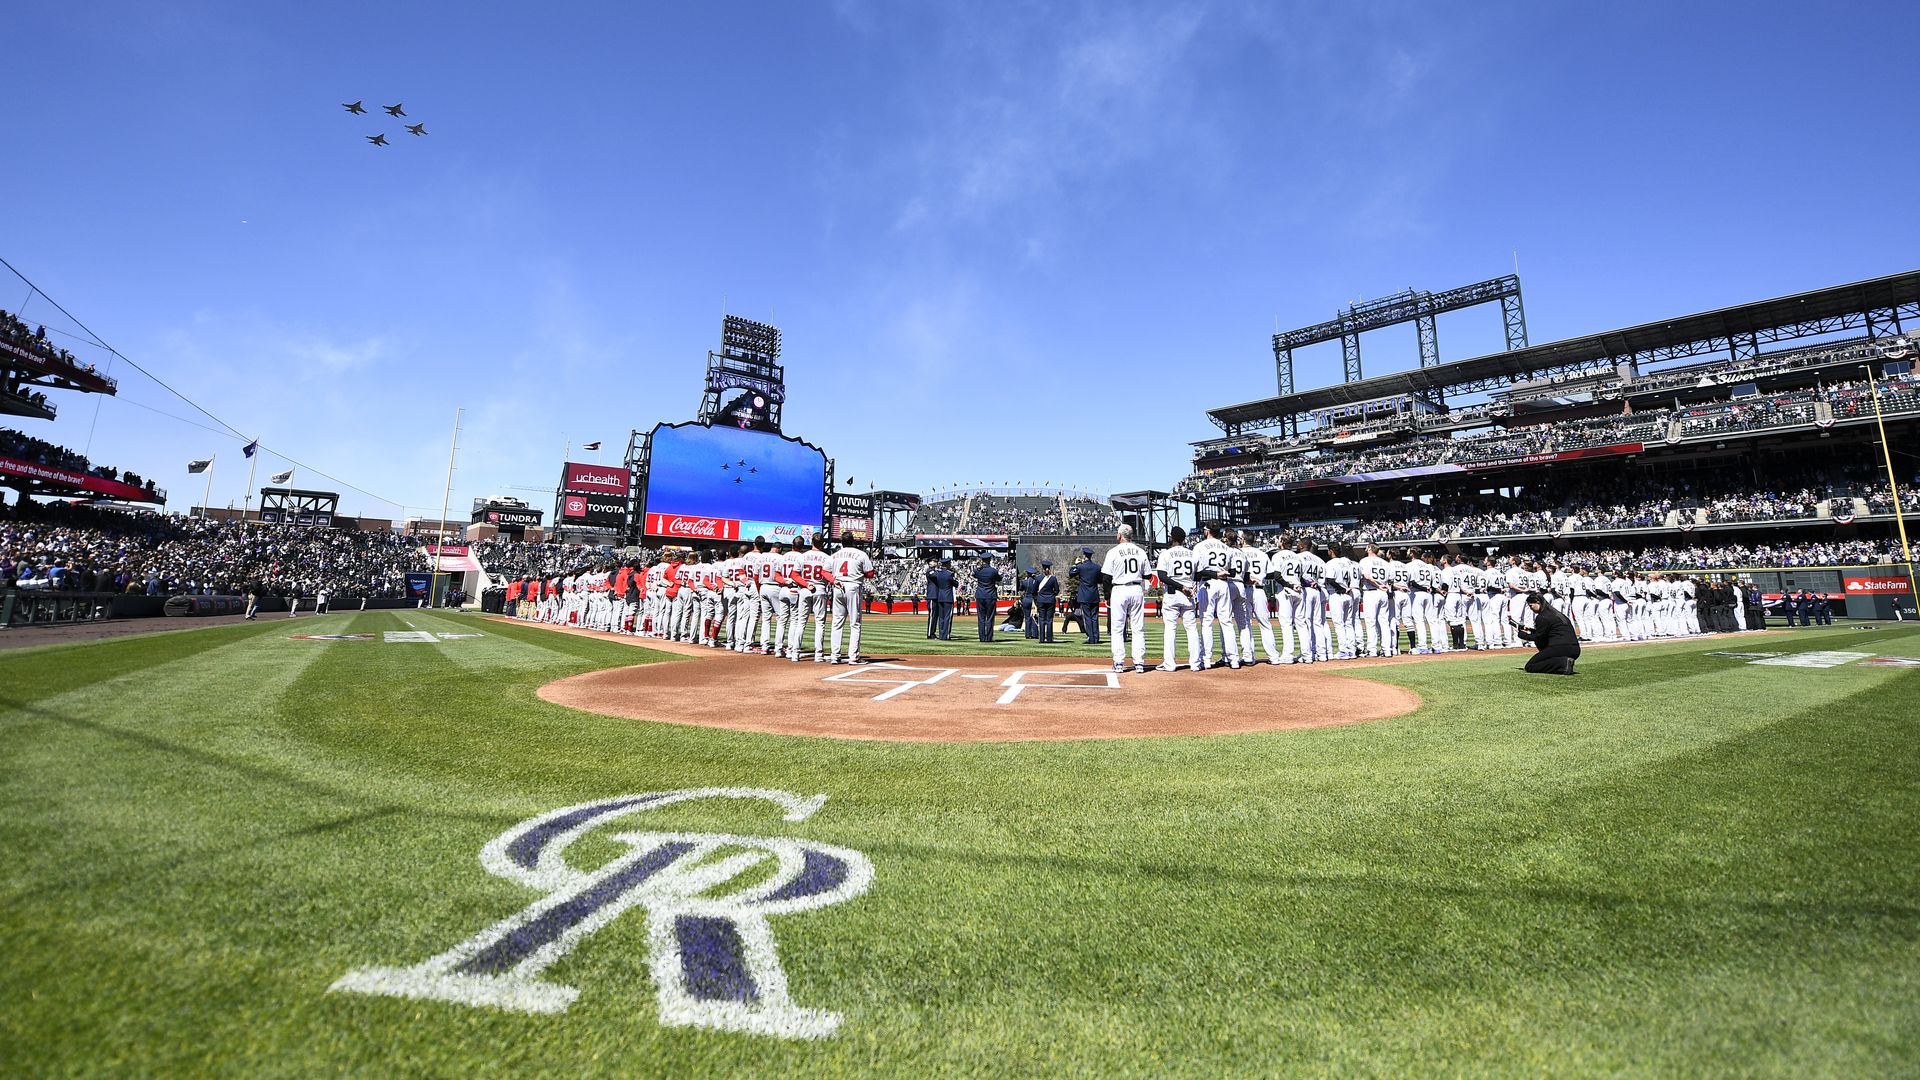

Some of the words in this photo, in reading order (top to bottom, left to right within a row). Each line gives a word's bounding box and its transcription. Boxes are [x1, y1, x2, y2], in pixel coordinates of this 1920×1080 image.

[19, 348, 28, 358] the
[28, 352, 45, 364] brave?
[1718, 373, 1755, 384] Silver
[1756, 371, 1777, 379] BULLET
[1539, 453, 1558, 461] brave?
[5, 460, 16, 470] free
[16, 464, 28, 473] and
[28, 466, 37, 475] the
[37, 468, 52, 478] home
[52, 471, 59, 479] of
[59, 473, 68, 482] the
[68, 475, 84, 485] brave?
[576, 472, 621, 487] uchealth
[587, 503, 625, 514] TOYOTA
[499, 513, 537, 523] TUNDRA
[669, 517, 718, 536] Coca-Cola
[774, 525, 798, 536] Chill
[1119, 548, 1139, 557] BLACK
[1124, 558, 1138, 574] 10
[1208, 551, 1226, 568] 23
[763, 564, 770, 578] 9
[782, 564, 795, 578] 17
[803, 564, 823, 580] 28
[839, 561, 849, 577] 4
[1173, 560, 1192, 576] 29
[1286, 562, 1301, 578] 24
[1306, 564, 1318, 579] 44
[1371, 567, 1386, 580] 59
[679, 570, 688, 581] 75
[695, 571, 700, 582] 5
[728, 569, 740, 581] 22
[1394, 570, 1408, 582] 55
[1419, 569, 1431, 581] 52
[1463, 575, 1476, 587] 48
[1519, 576, 1529, 586] 39
